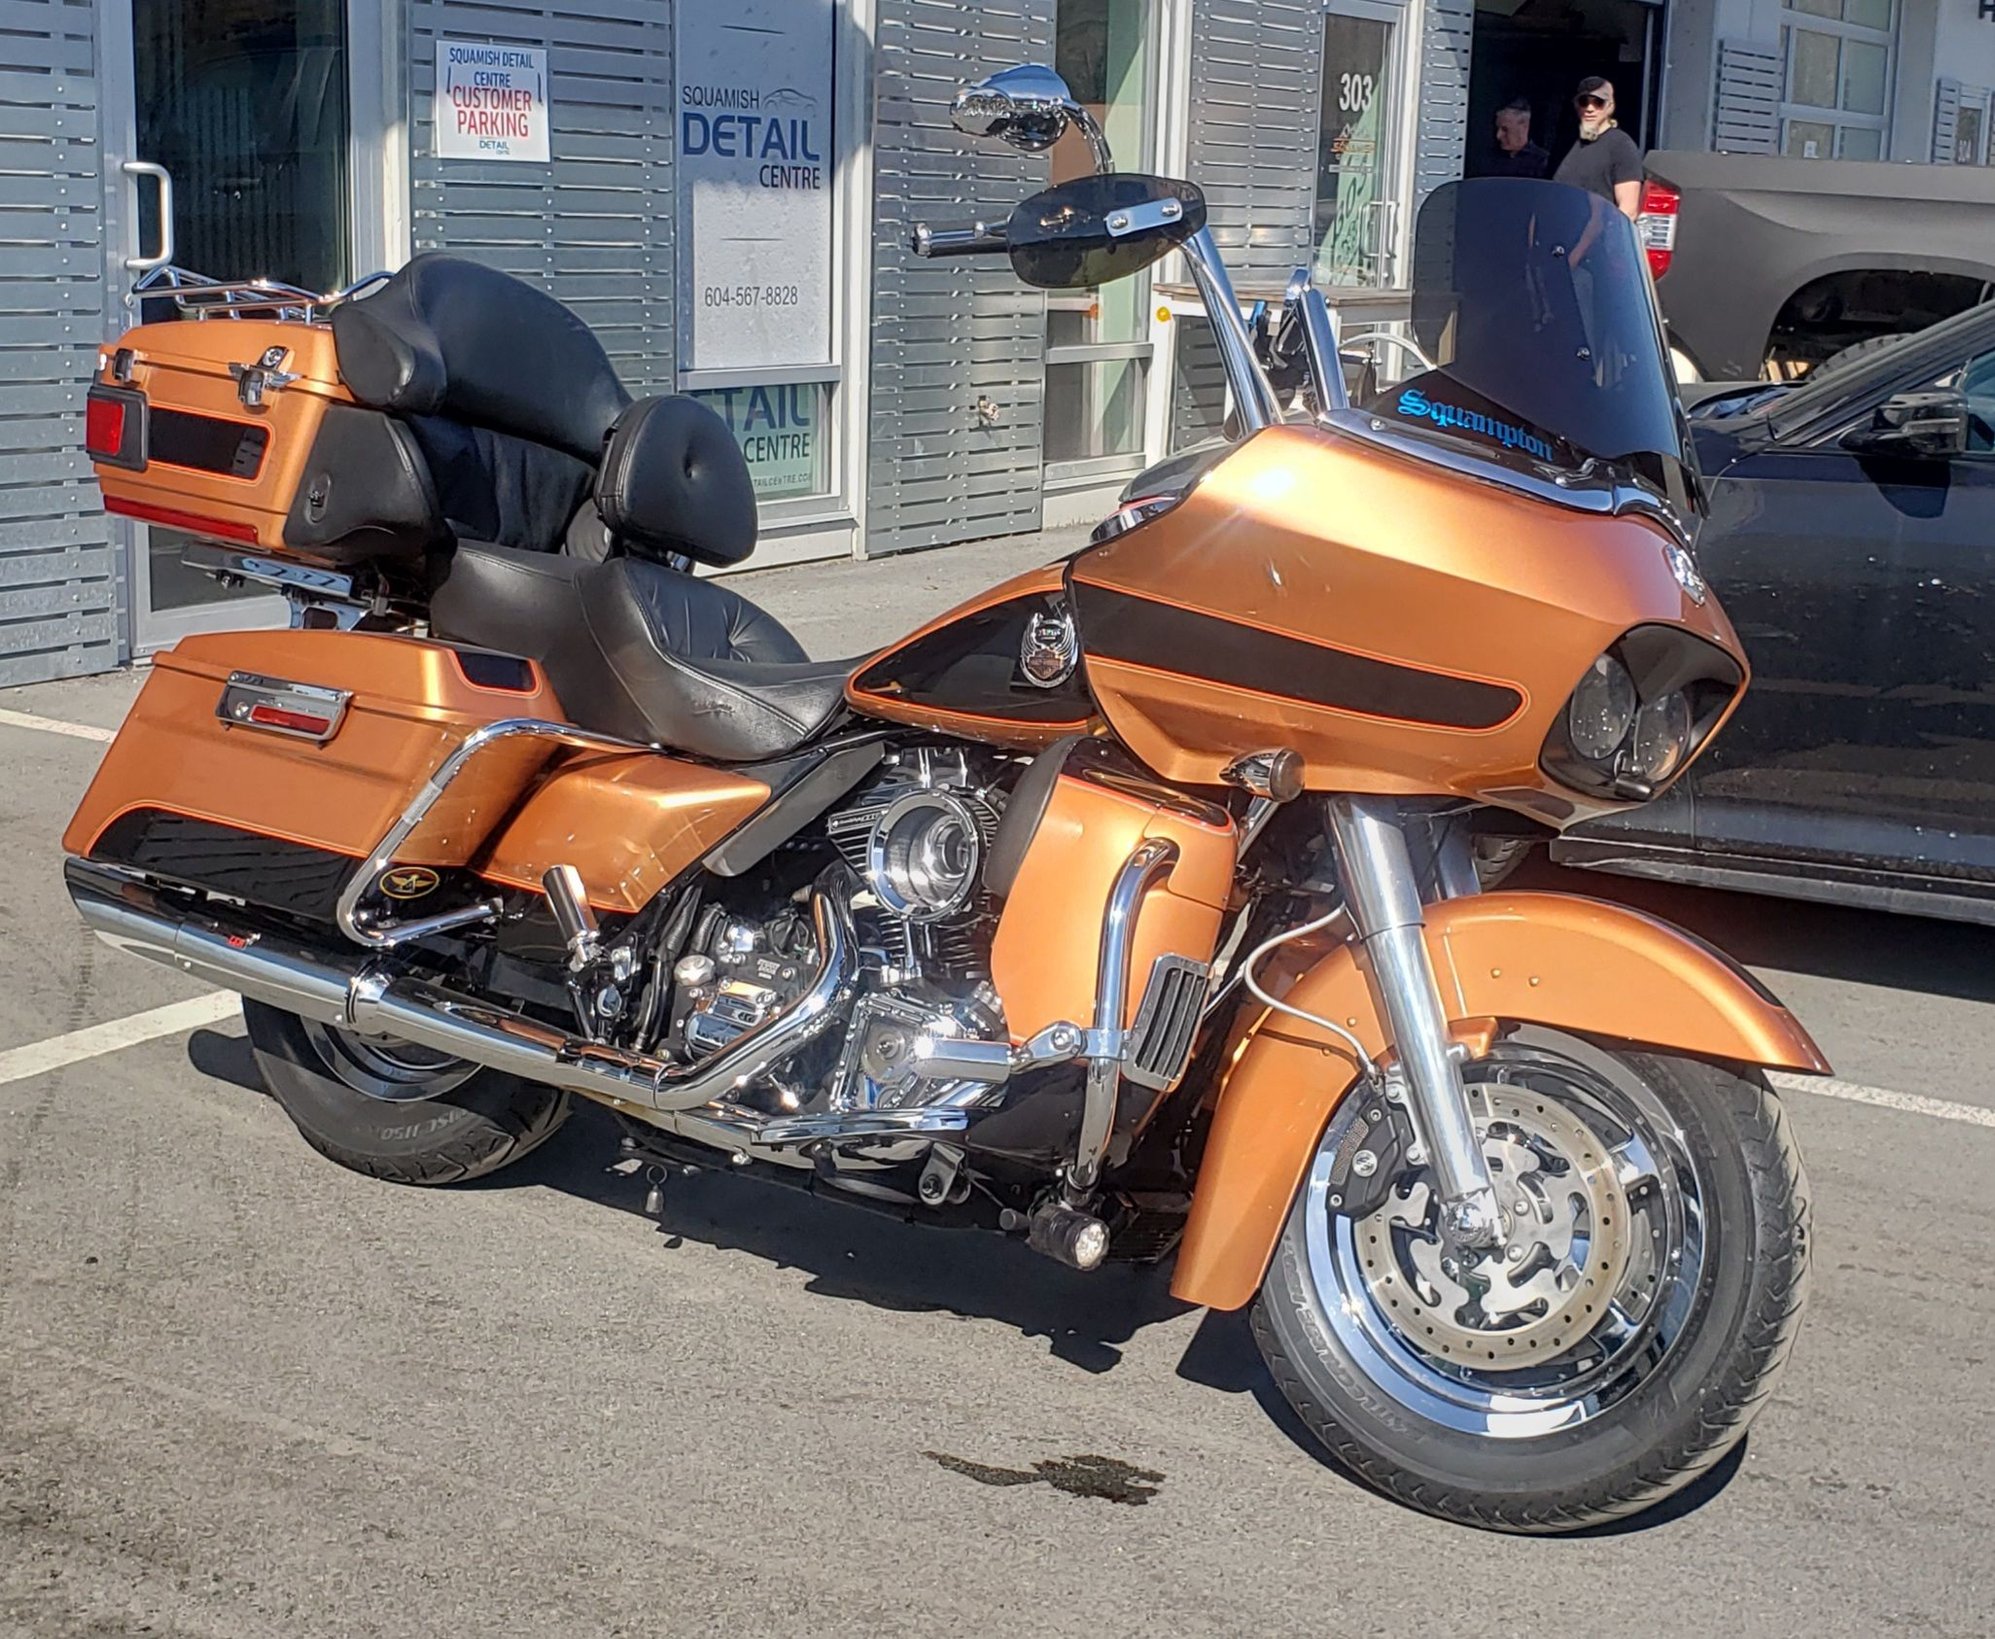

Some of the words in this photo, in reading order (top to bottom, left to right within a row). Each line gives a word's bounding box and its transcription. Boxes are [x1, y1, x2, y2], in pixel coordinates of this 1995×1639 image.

[449, 47, 500, 66] SQUAMISH
[502, 52, 534, 69] DETAIL
[474, 71, 512, 88] CENTRE
[1339, 72, 1373, 112] 303
[453, 85, 532, 111] CUSTOMER
[682, 85, 760, 110] SQUAMISH
[457, 110, 529, 137] PARKING
[682, 112, 820, 161] DETAIL
[479, 140, 509, 150] DETAIL
[759, 164, 821, 190] CENTRE
[704, 286, 798, 307] 604-567-8828
[695, 385, 810, 432] TAIL
[1397, 389, 1553, 462] Squampton
[744, 433, 810, 463] CENTRE
